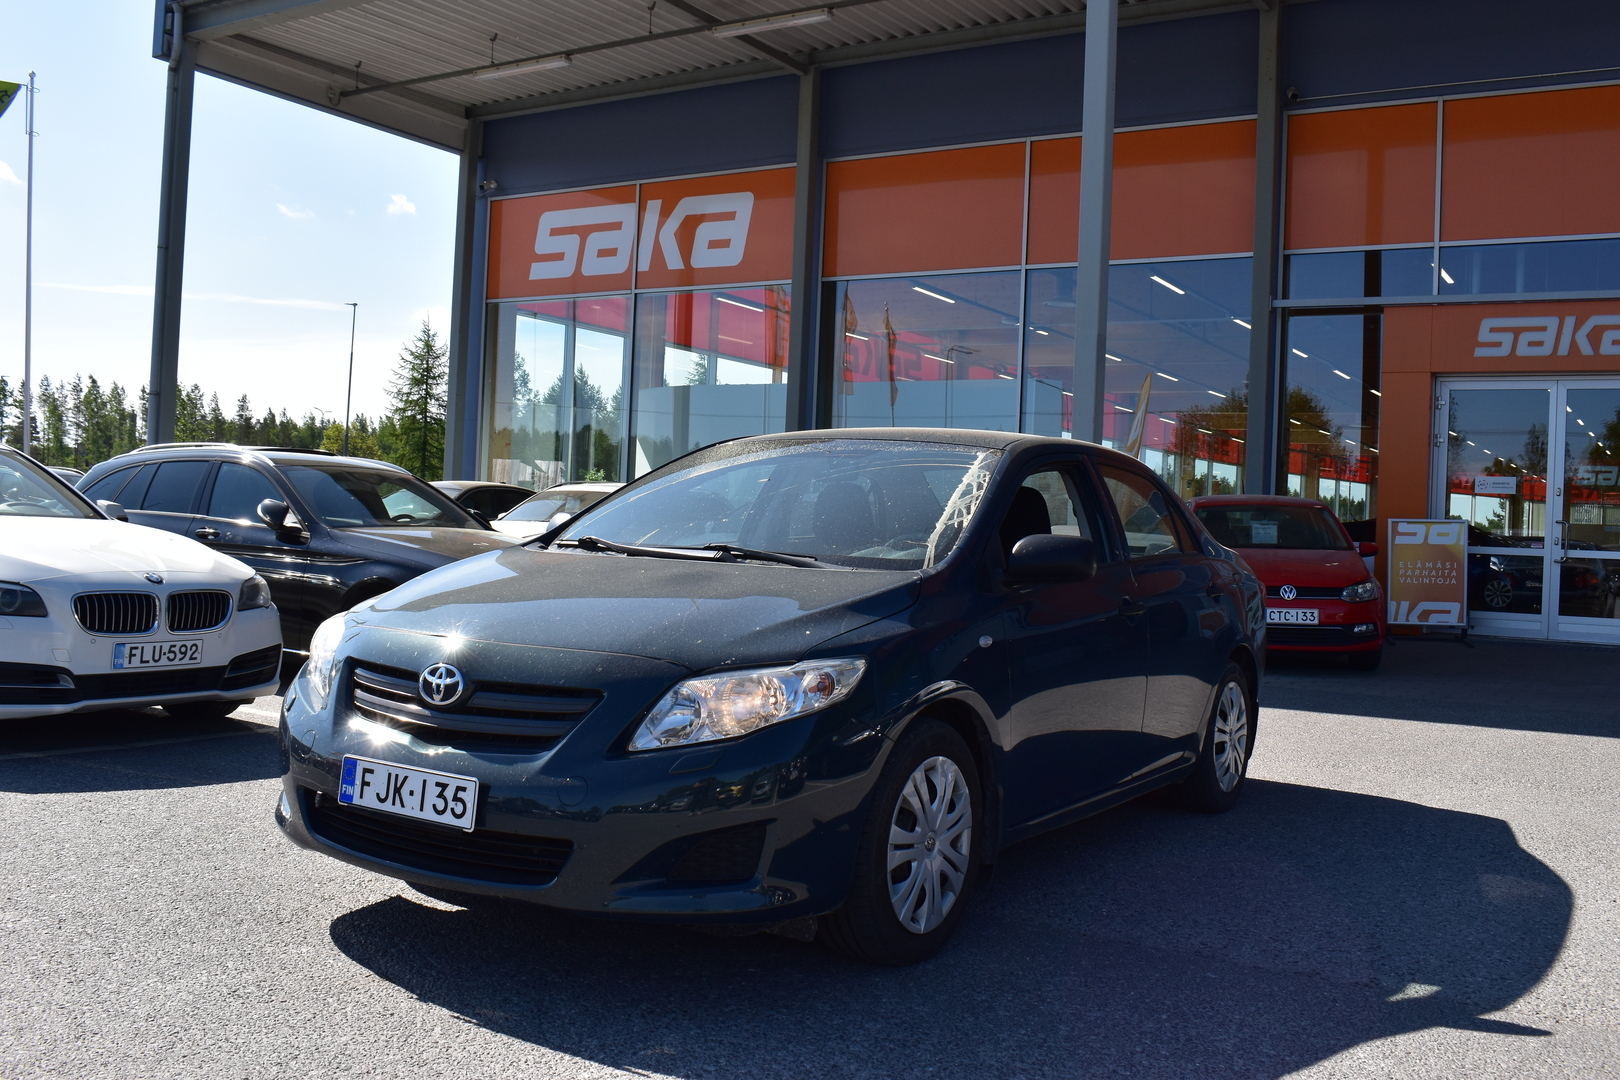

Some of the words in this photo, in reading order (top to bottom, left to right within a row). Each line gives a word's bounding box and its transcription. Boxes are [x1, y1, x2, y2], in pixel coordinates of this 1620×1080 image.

[528, 191, 755, 280] saka
[1576, 465, 1620, 486] sa
[1394, 522, 1465, 545] sa
[1399, 560, 1457, 568] ELÄMÄSI
[1399, 569, 1457, 577] PARHAITA
[1399, 577, 1457, 585] VALINTOJA
[1268, 610, 1316, 622] CTC-133
[128, 643, 199, 664] FLU-592
[341, 784, 354, 796] FIN
[358, 767, 469, 819] FJK-135
